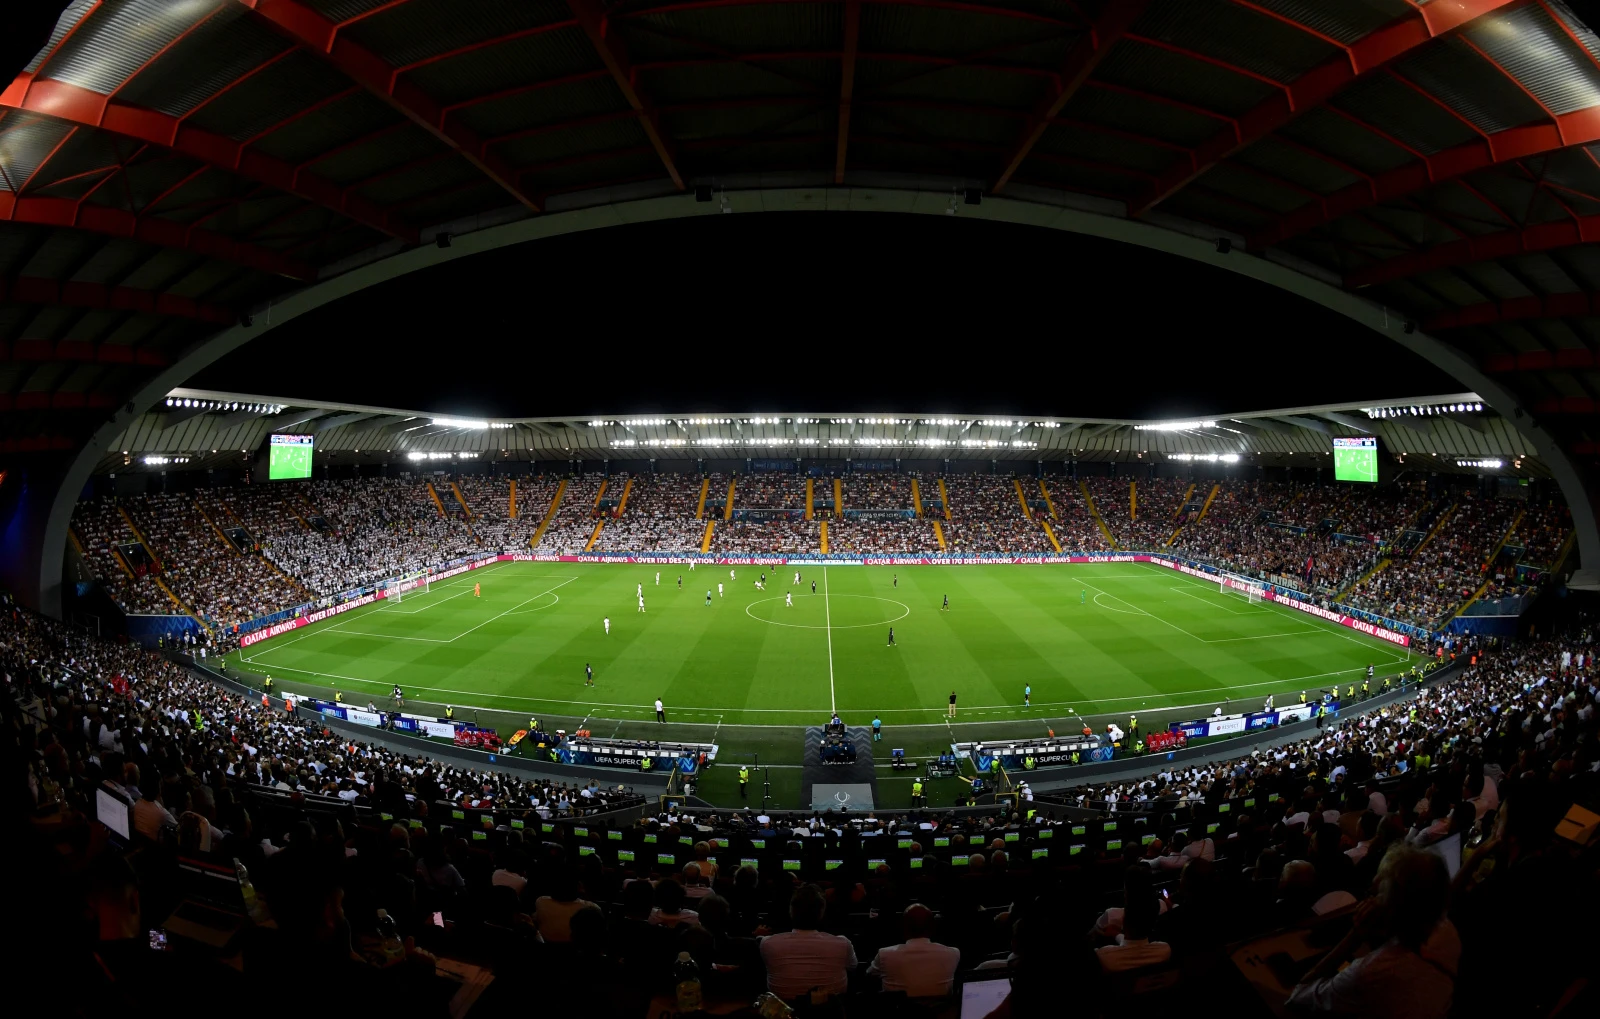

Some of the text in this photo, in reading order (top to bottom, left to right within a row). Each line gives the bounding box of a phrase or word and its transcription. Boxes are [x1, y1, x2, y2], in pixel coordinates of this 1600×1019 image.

[444, 565, 468, 578] DESTINATIONS
[1270, 574, 1298, 590] ULTRAS
[309, 593, 374, 623] OVER 170 DESTINATIONS
[1276, 595, 1340, 623] OVER 170 DESTINATIONS
[244, 620, 296, 645] QATAR AIRWAYS
[1352, 620, 1405, 645] QATAR AIRWAYS
